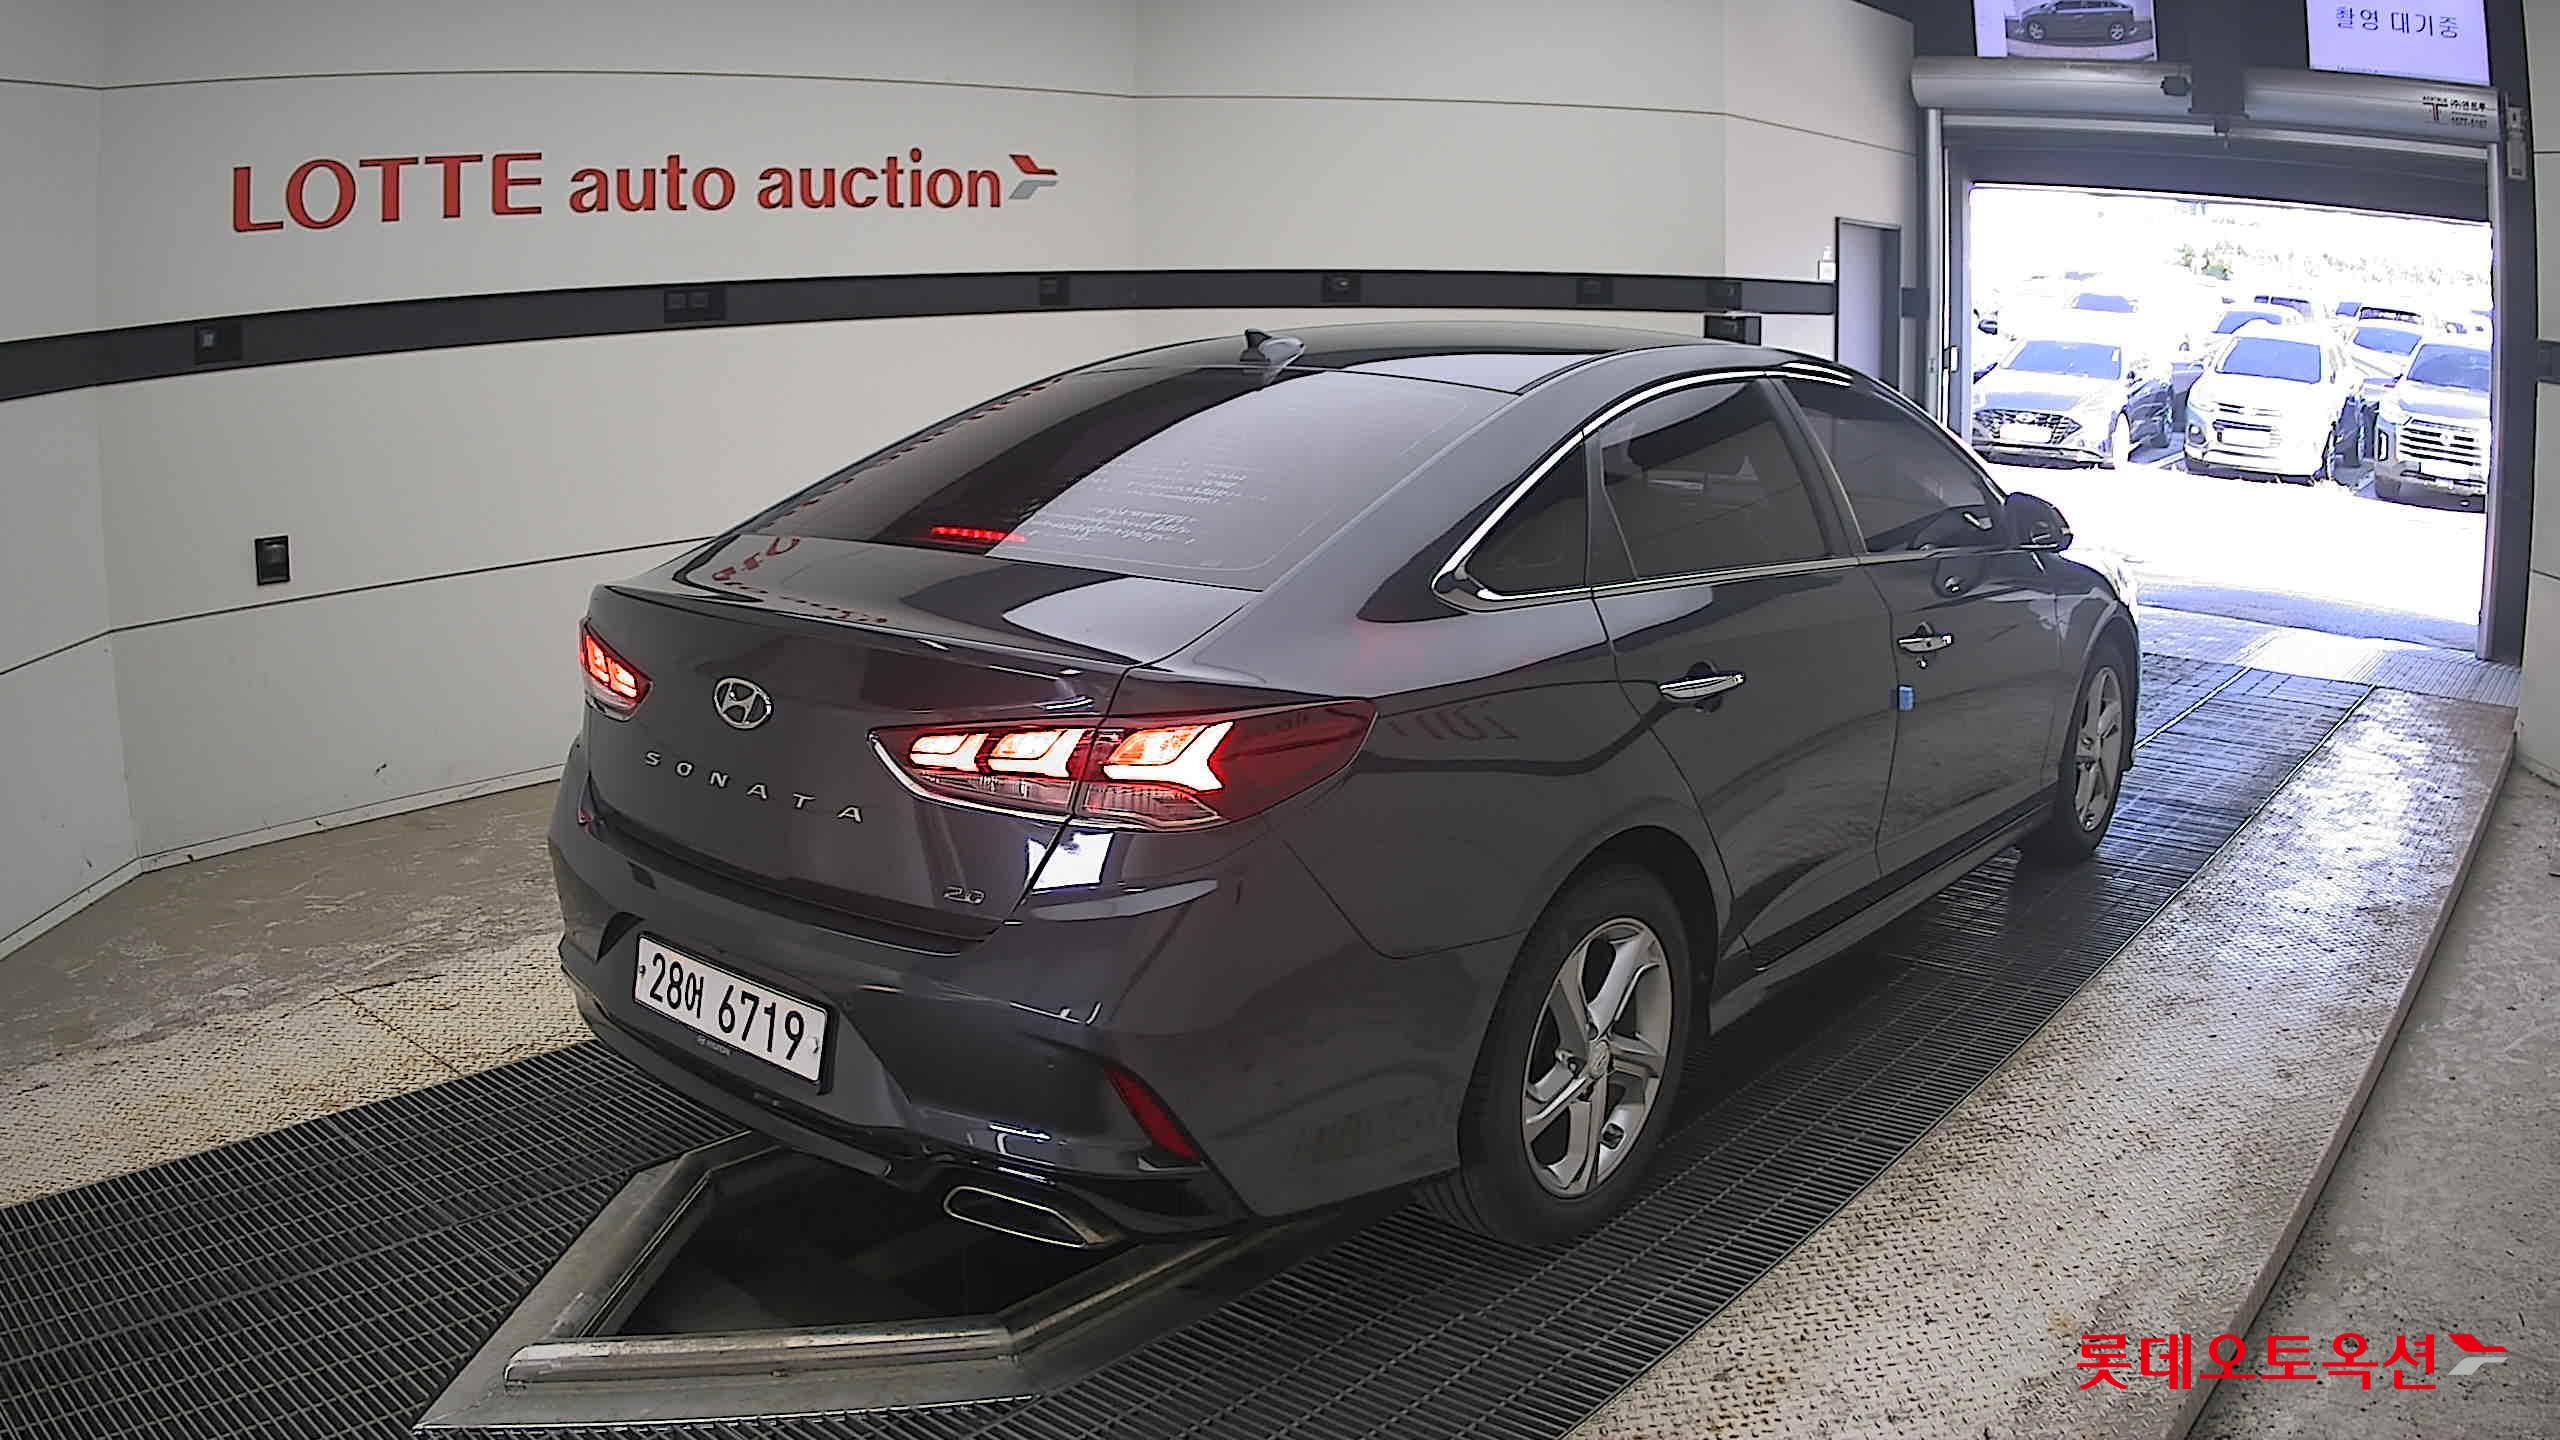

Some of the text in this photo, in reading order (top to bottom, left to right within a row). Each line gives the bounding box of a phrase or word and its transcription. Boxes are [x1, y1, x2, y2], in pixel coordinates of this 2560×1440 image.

[2336, 6, 2458, 39] 촬영 대기중
[232, 147, 1002, 233] LOTTE auto auction
[644, 751, 864, 823] SONATA
[649, 952, 805, 1061] 28어 6719
